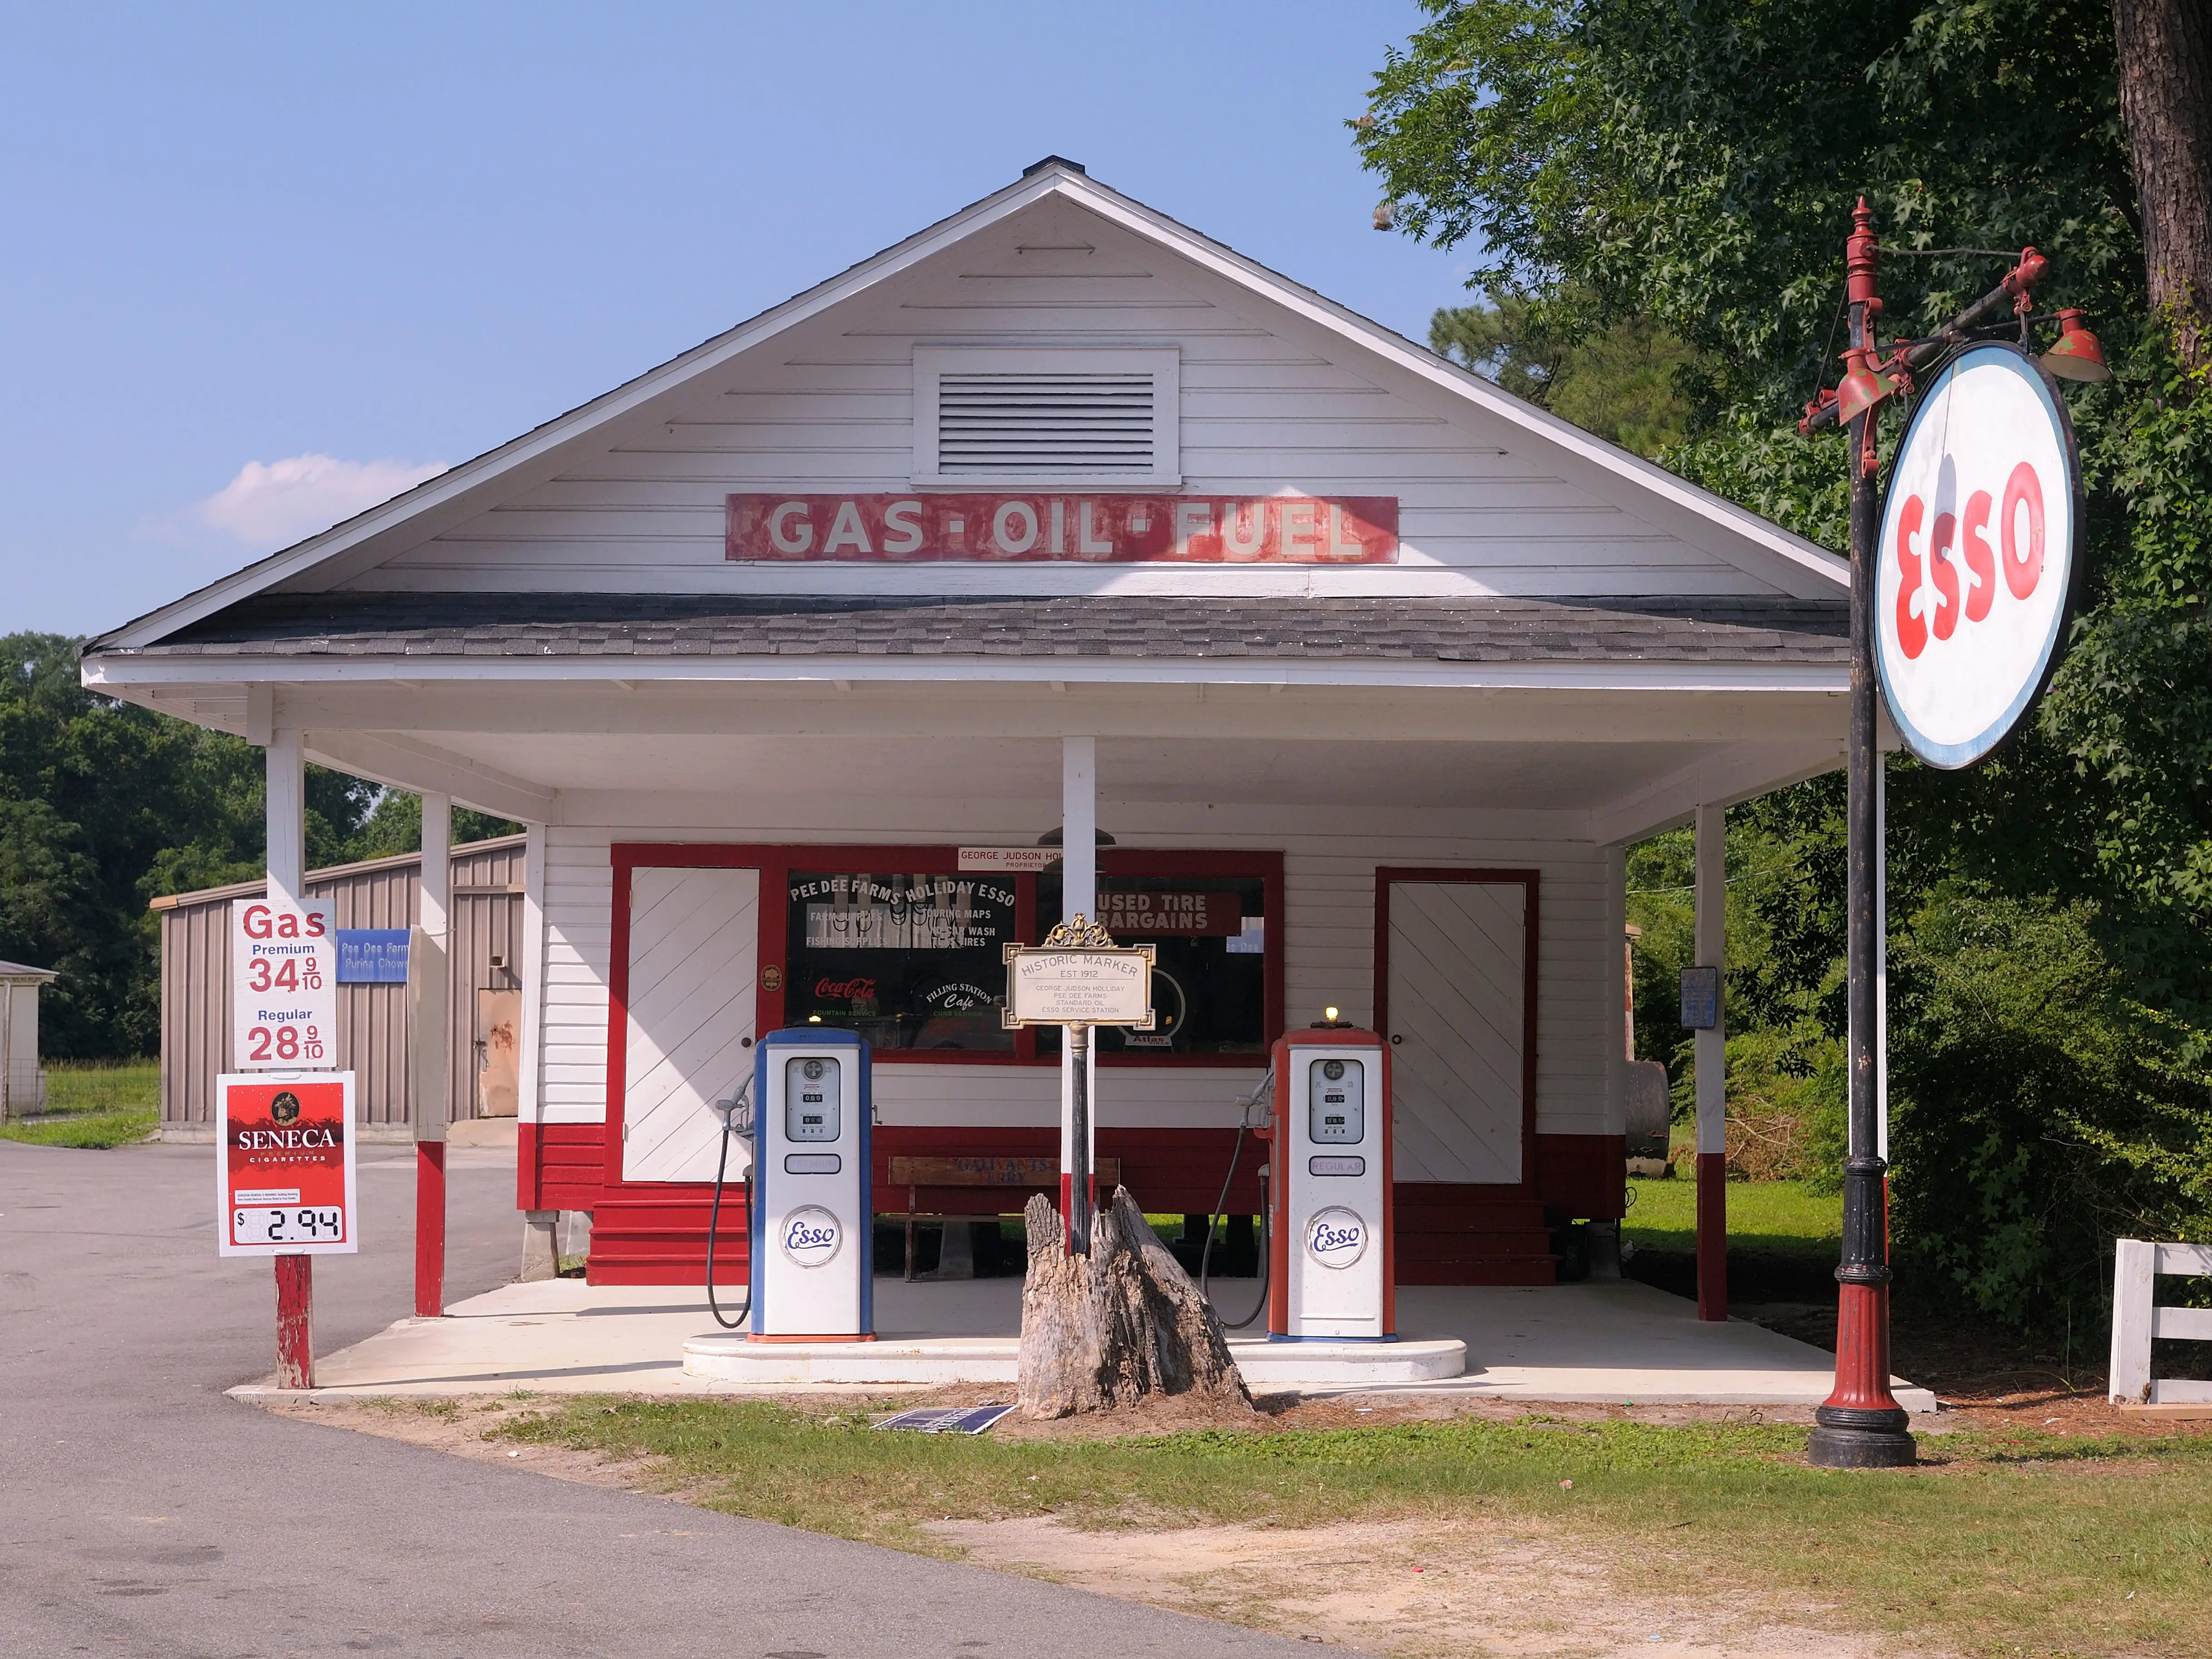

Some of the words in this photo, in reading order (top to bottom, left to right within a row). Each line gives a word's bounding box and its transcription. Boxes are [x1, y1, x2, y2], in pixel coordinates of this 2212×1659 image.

[769, 501, 924, 554] GAS
[992, 500, 1113, 554] OIL
[1176, 502, 1364, 556] FUEL
[1896, 461, 2045, 660] ESSO
[961, 851, 999, 859] GEORGE
[790, 882, 818, 901] PEE
[820, 879, 848, 893] DEE
[851, 880, 901, 905] FARMS
[905, 881, 975, 903] HOLLIDAY
[978, 884, 1015, 906] ESSO
[1097, 894, 1151, 911] USED
[1161, 895, 1206, 911] TIRE
[243, 905, 326, 939] Gas
[810, 912, 836, 921] FARM
[964, 909, 991, 919] MAPS
[1096, 911, 1208, 929] BARGAINS
[968, 927, 995, 936] WASH
[252, 943, 315, 955] Premium
[342, 942, 359, 953] Pee
[364, 942, 382, 953] Dee
[806, 937, 843, 946] FISHING
[844, 937, 888, 946] SUPPLIES
[346, 957, 374, 969] Purina
[1021, 955, 1077, 977] HISTORIC
[1084, 955, 1138, 977] MARKER
[249, 957, 299, 992] 34
[815, 977, 877, 998] Coca-Cola
[926, 983, 957, 1003] FILLING
[959, 983, 993, 1004] STATION
[944, 993, 975, 1010] Cafe
[258, 1009, 312, 1023] Regular
[248, 1025, 300, 1061] 28
[239, 1129, 337, 1150] SENECA
[1312, 1161, 1361, 1172] REGULAR
[268, 1210, 338, 1240] 2.94
[787, 1222, 835, 1250] Esso
[1313, 1223, 1360, 1252] Esso
